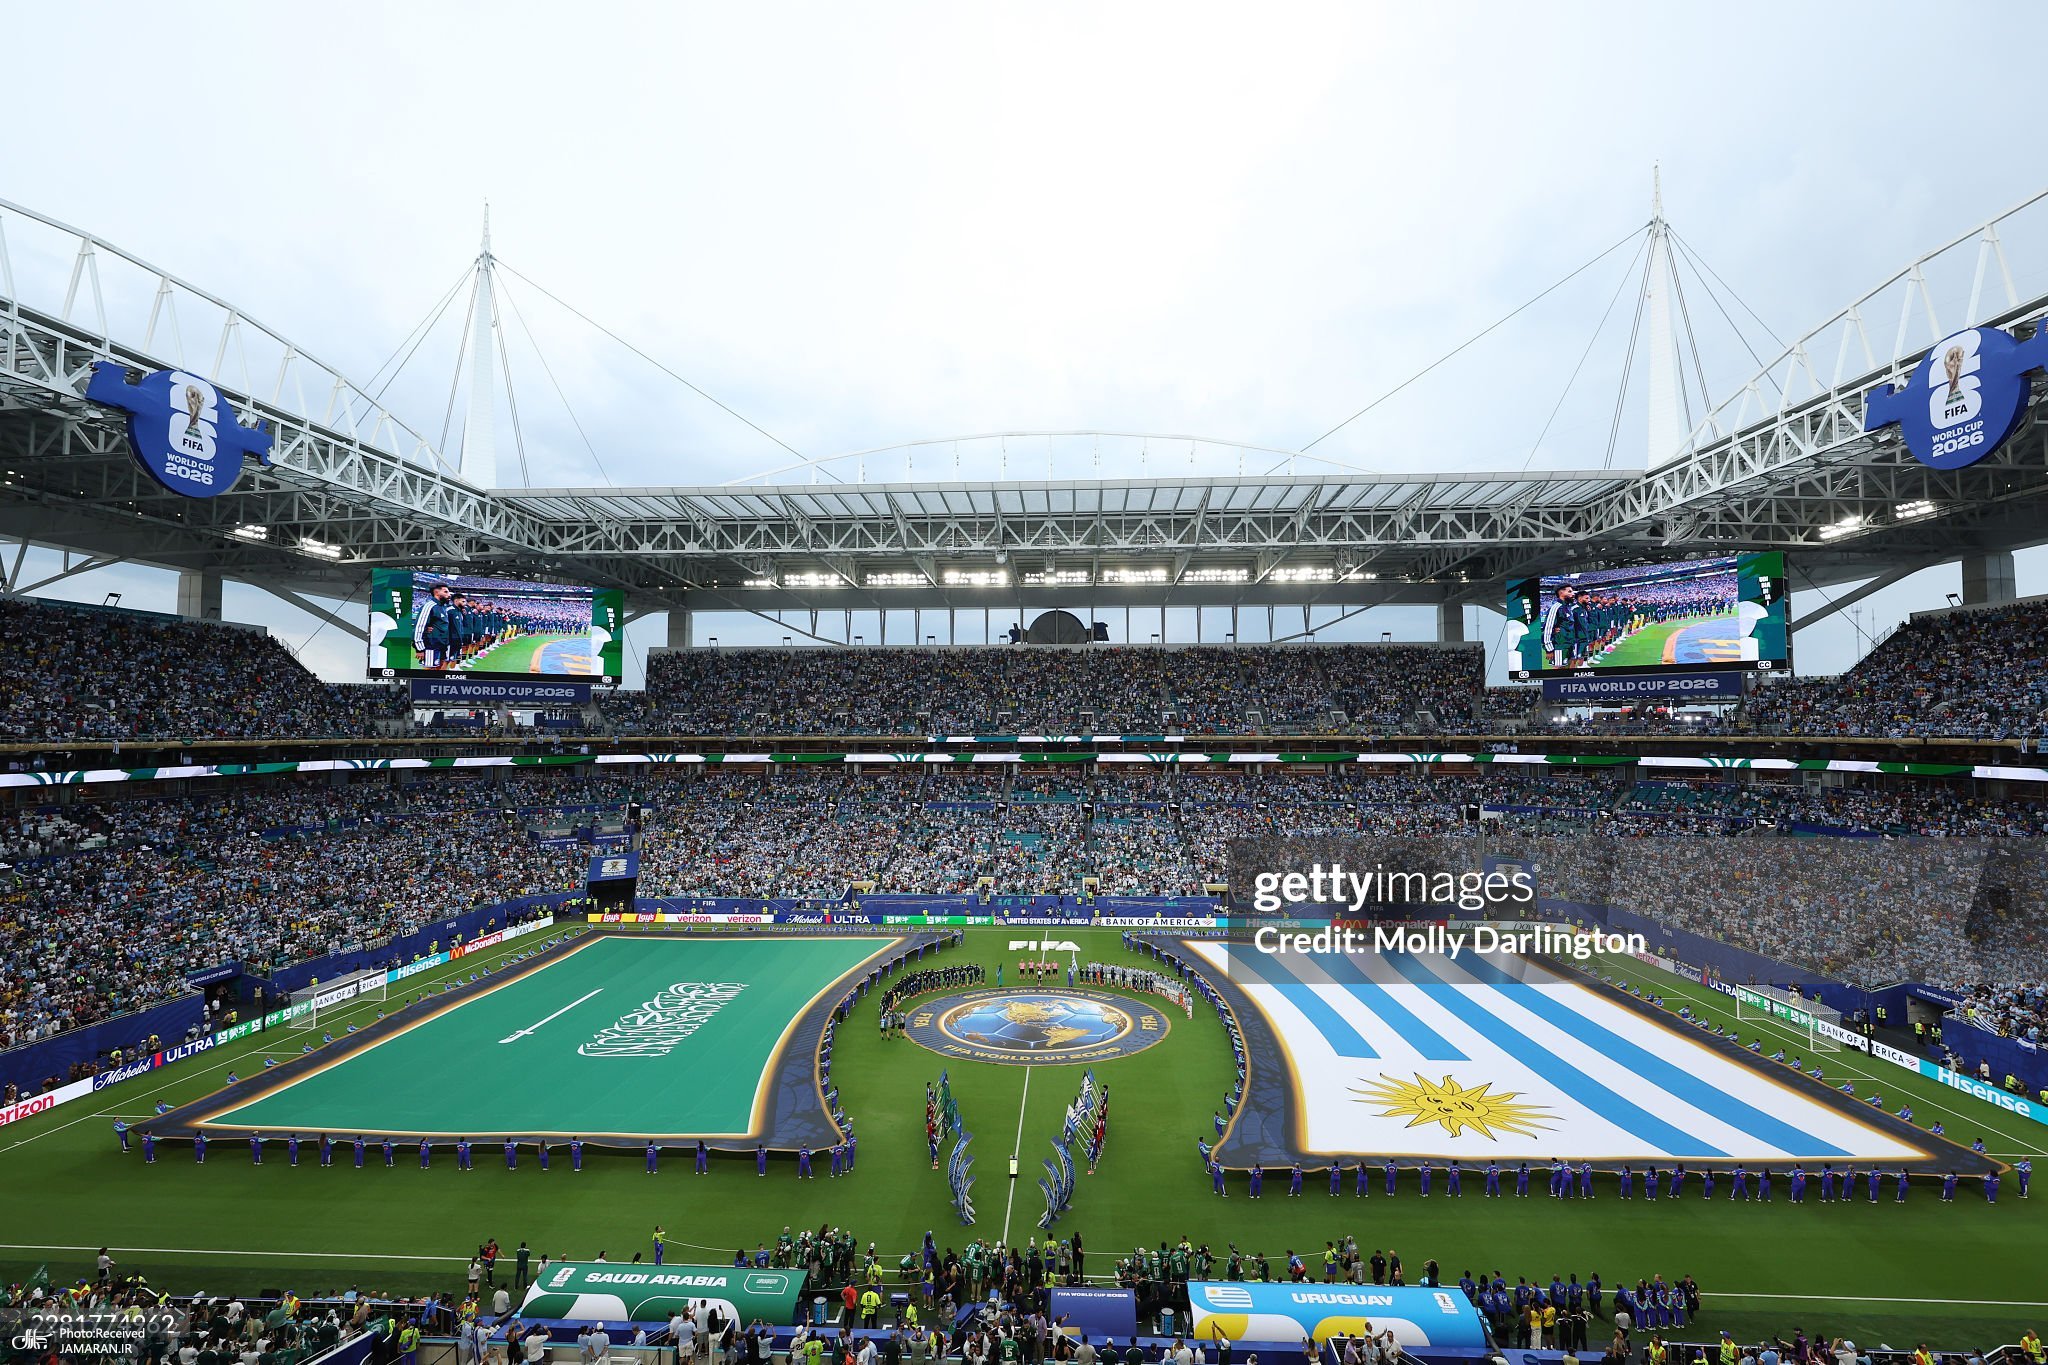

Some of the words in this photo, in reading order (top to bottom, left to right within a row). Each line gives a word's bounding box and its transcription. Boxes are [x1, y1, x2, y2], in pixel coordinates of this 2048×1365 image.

[1944, 403, 1968, 419] FIFA
[1931, 427, 1964, 444] WORLD
[1964, 420, 1984, 433] CUP
[182, 437, 204, 453] FIFA
[1932, 430, 1984, 458] 2026
[166, 452, 198, 468] WORLD
[198, 462, 215, 473] CUP
[164, 461, 214, 486] 2026
[430, 684, 459, 695] FIFA
[460, 685, 507, 696] WORLD
[508, 686, 533, 696] CUP
[534, 687, 575, 697] 2026
[1560, 683, 1587, 694] FIFA
[1588, 681, 1636, 692] WORLD
[1637, 680, 1666, 691] CUP
[1667, 678, 1719, 690] 2026
[446, 921, 457, 930] FIFA
[677, 914, 712, 923] verizon
[727, 914, 762, 923] verizon
[785, 914, 823, 924] Michelob
[833, 915, 871, 924] ULTRA
[1006, 917, 1029, 925] UNITED
[1029, 917, 1052, 925] STATES
[1052, 917, 1061, 925] OF
[1105, 918, 1134, 926] BANK
[1137, 918, 1150, 926] OF
[1152, 918, 1201, 926] AMERICA
[1246, 918, 1301, 928] Hisense
[1367, 919, 1437, 929] McDonald's
[1662, 928, 1674, 938] FIFA
[464, 932, 503, 954] McDonald's
[1008, 940, 1081, 952] FIFA
[1634, 950, 1660, 967] verizon
[396, 956, 442, 980] Hisense
[1675, 964, 1702, 984] Michelob
[1709, 977, 1737, 996] ULTRA
[336, 989, 346, 999] OF
[914, 1012, 933, 1028] FIFA
[1139, 1014, 1158, 1031] FIFA
[1820, 1023, 1845, 1040] BANK
[1846, 1034, 1858, 1045] OF
[1860, 1039, 1905, 1064] AERICA
[944, 1044, 972, 1055] FIFA
[974, 1051, 1031, 1061] WORLD
[1069, 1046, 1122, 1060] 2026
[94, 1057, 152, 1091] Michelob
[166, 1036, 215, 1063] ULTRA
[1937, 1065, 2031, 1118] Hisense
[0, 1094, 55, 1127] erizon
[584, 1272, 650, 1285] SAUDI
[648, 1274, 728, 1287] ARABIA
[1290, 1292, 1393, 1306] URUGUAY
[1005, 1347, 1014, 1358] 15
